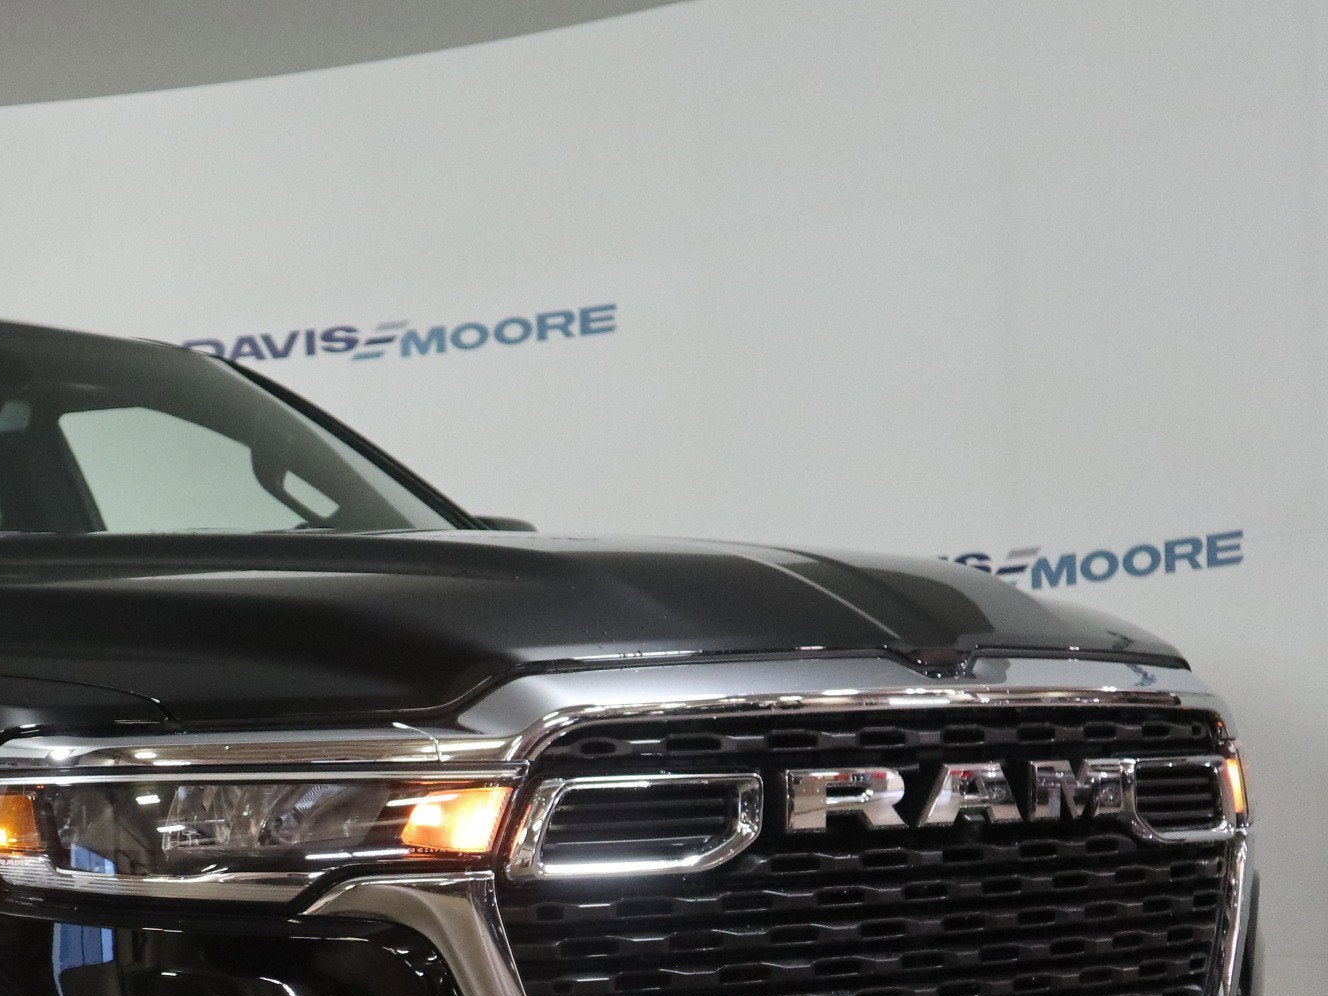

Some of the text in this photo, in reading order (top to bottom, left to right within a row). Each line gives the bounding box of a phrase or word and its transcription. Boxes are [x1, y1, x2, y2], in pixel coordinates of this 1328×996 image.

[400, 303, 618, 358] MOORE
[1030, 530, 1244, 590] MOORE
[785, 758, 1130, 833] RAM
